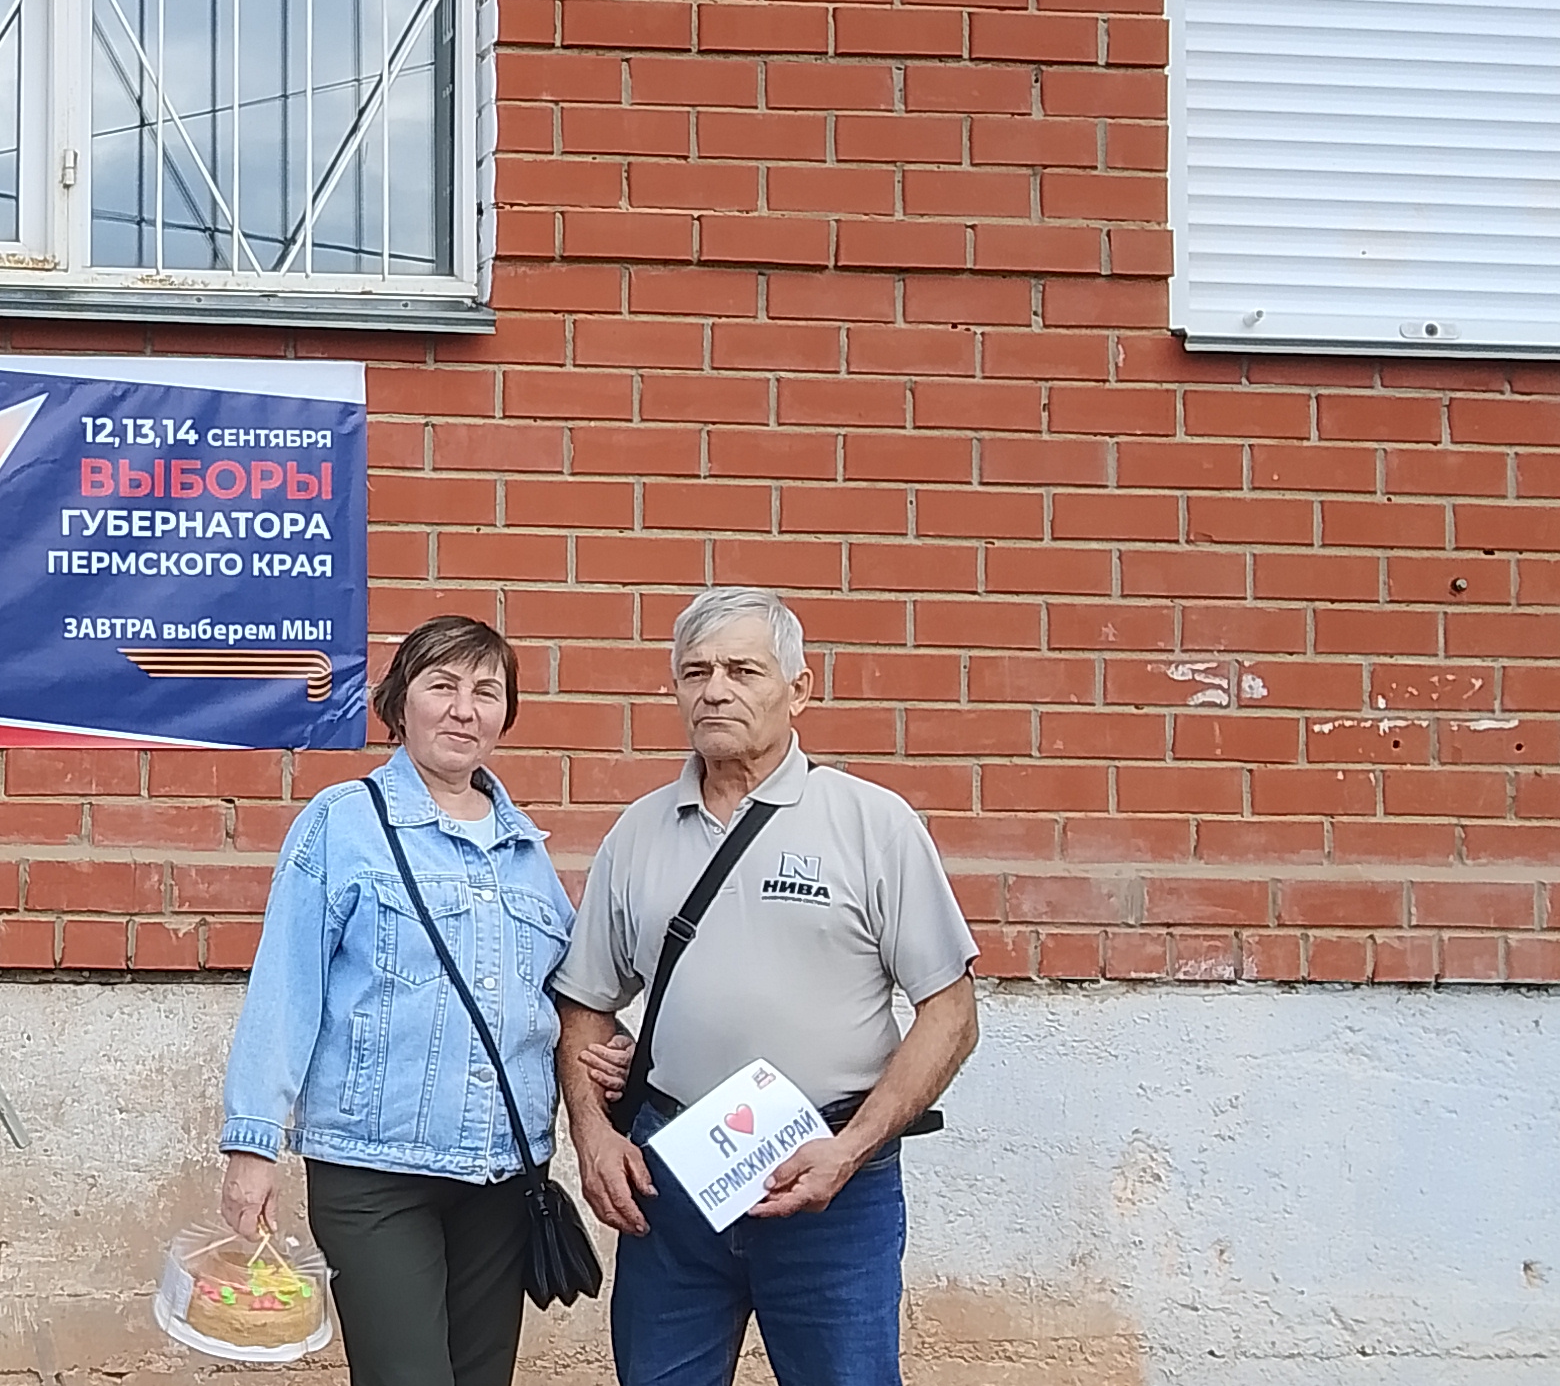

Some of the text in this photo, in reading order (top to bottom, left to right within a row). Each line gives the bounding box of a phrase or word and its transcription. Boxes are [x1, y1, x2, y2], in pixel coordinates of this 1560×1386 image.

[82, 416, 332, 449] 12,13,14 СЕНТЯБРЯ
[81, 458, 332, 500] ВЫБОРЫ
[61, 509, 331, 540] ГУБЕРНАТОРА
[48, 550, 332, 577] ПЕРМСКОГО КРАЯ
[64, 618, 332, 645] ЗАВТРА выберем МЫ!
[762, 880, 831, 899] НИВА
[709, 1125, 738, 1159] Я
[698, 1107, 819, 1211] ПЕРМСКИЙ КРАЙ
